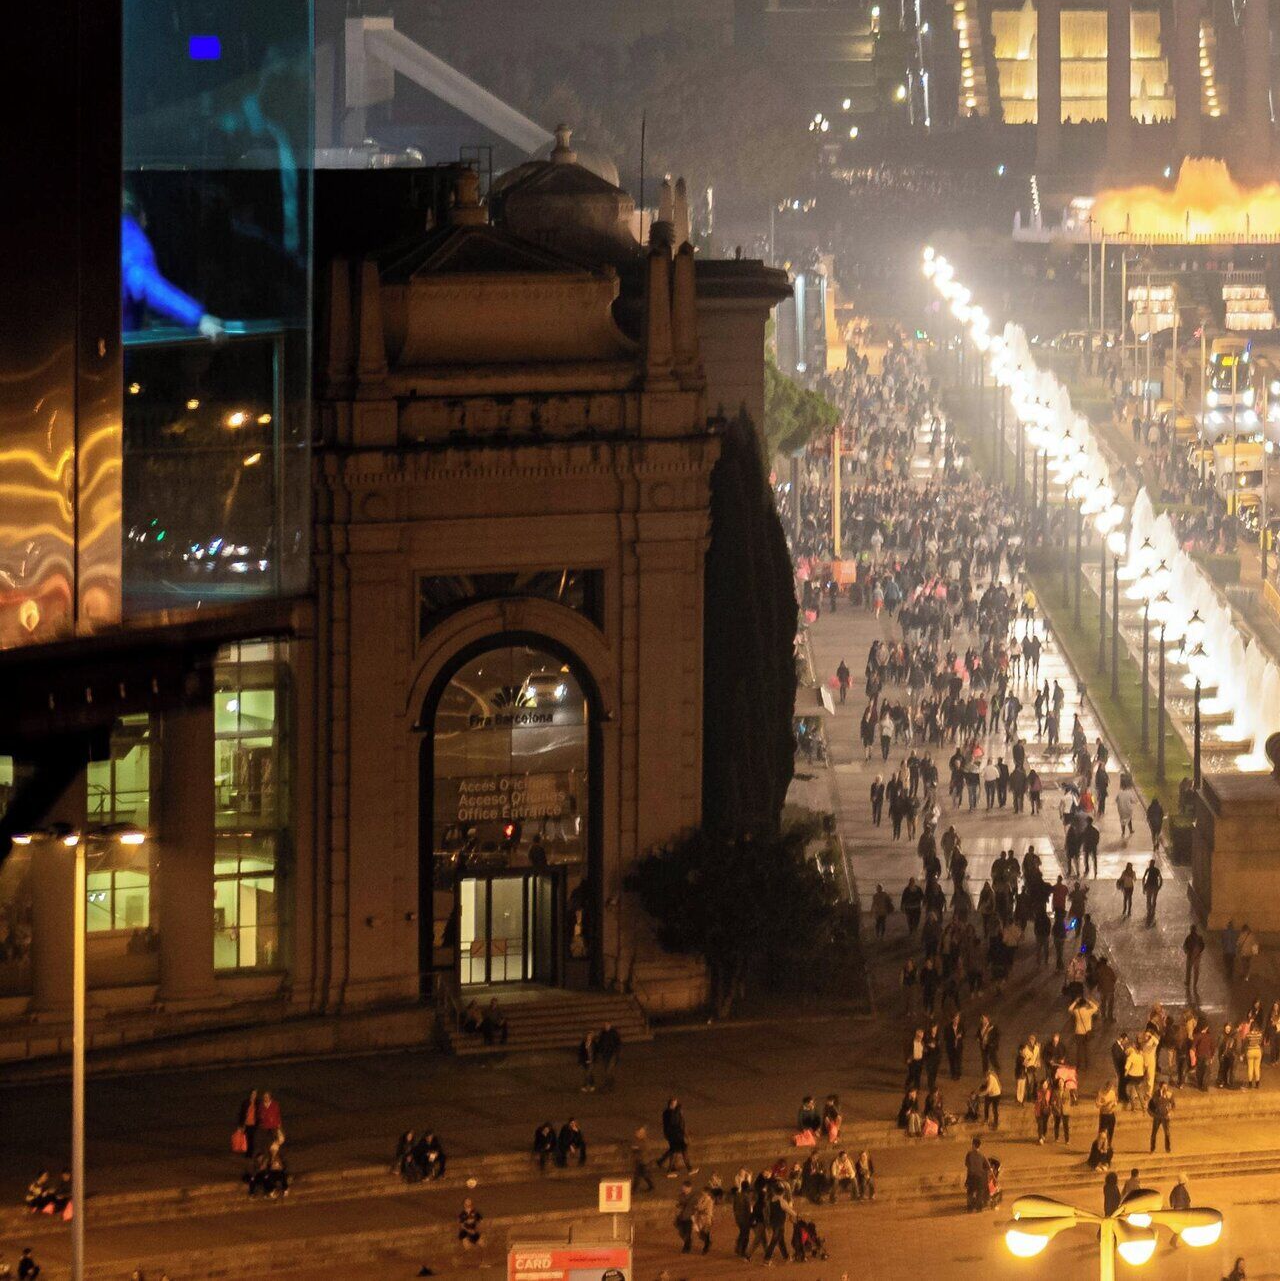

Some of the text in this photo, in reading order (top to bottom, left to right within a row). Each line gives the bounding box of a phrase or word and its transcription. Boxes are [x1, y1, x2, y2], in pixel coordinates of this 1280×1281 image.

[495, 712, 554, 725] Barcelona
[459, 794, 507, 807] Acceso
[458, 804, 562, 821] Office Entrance
[515, 1259, 552, 1270] CARD
